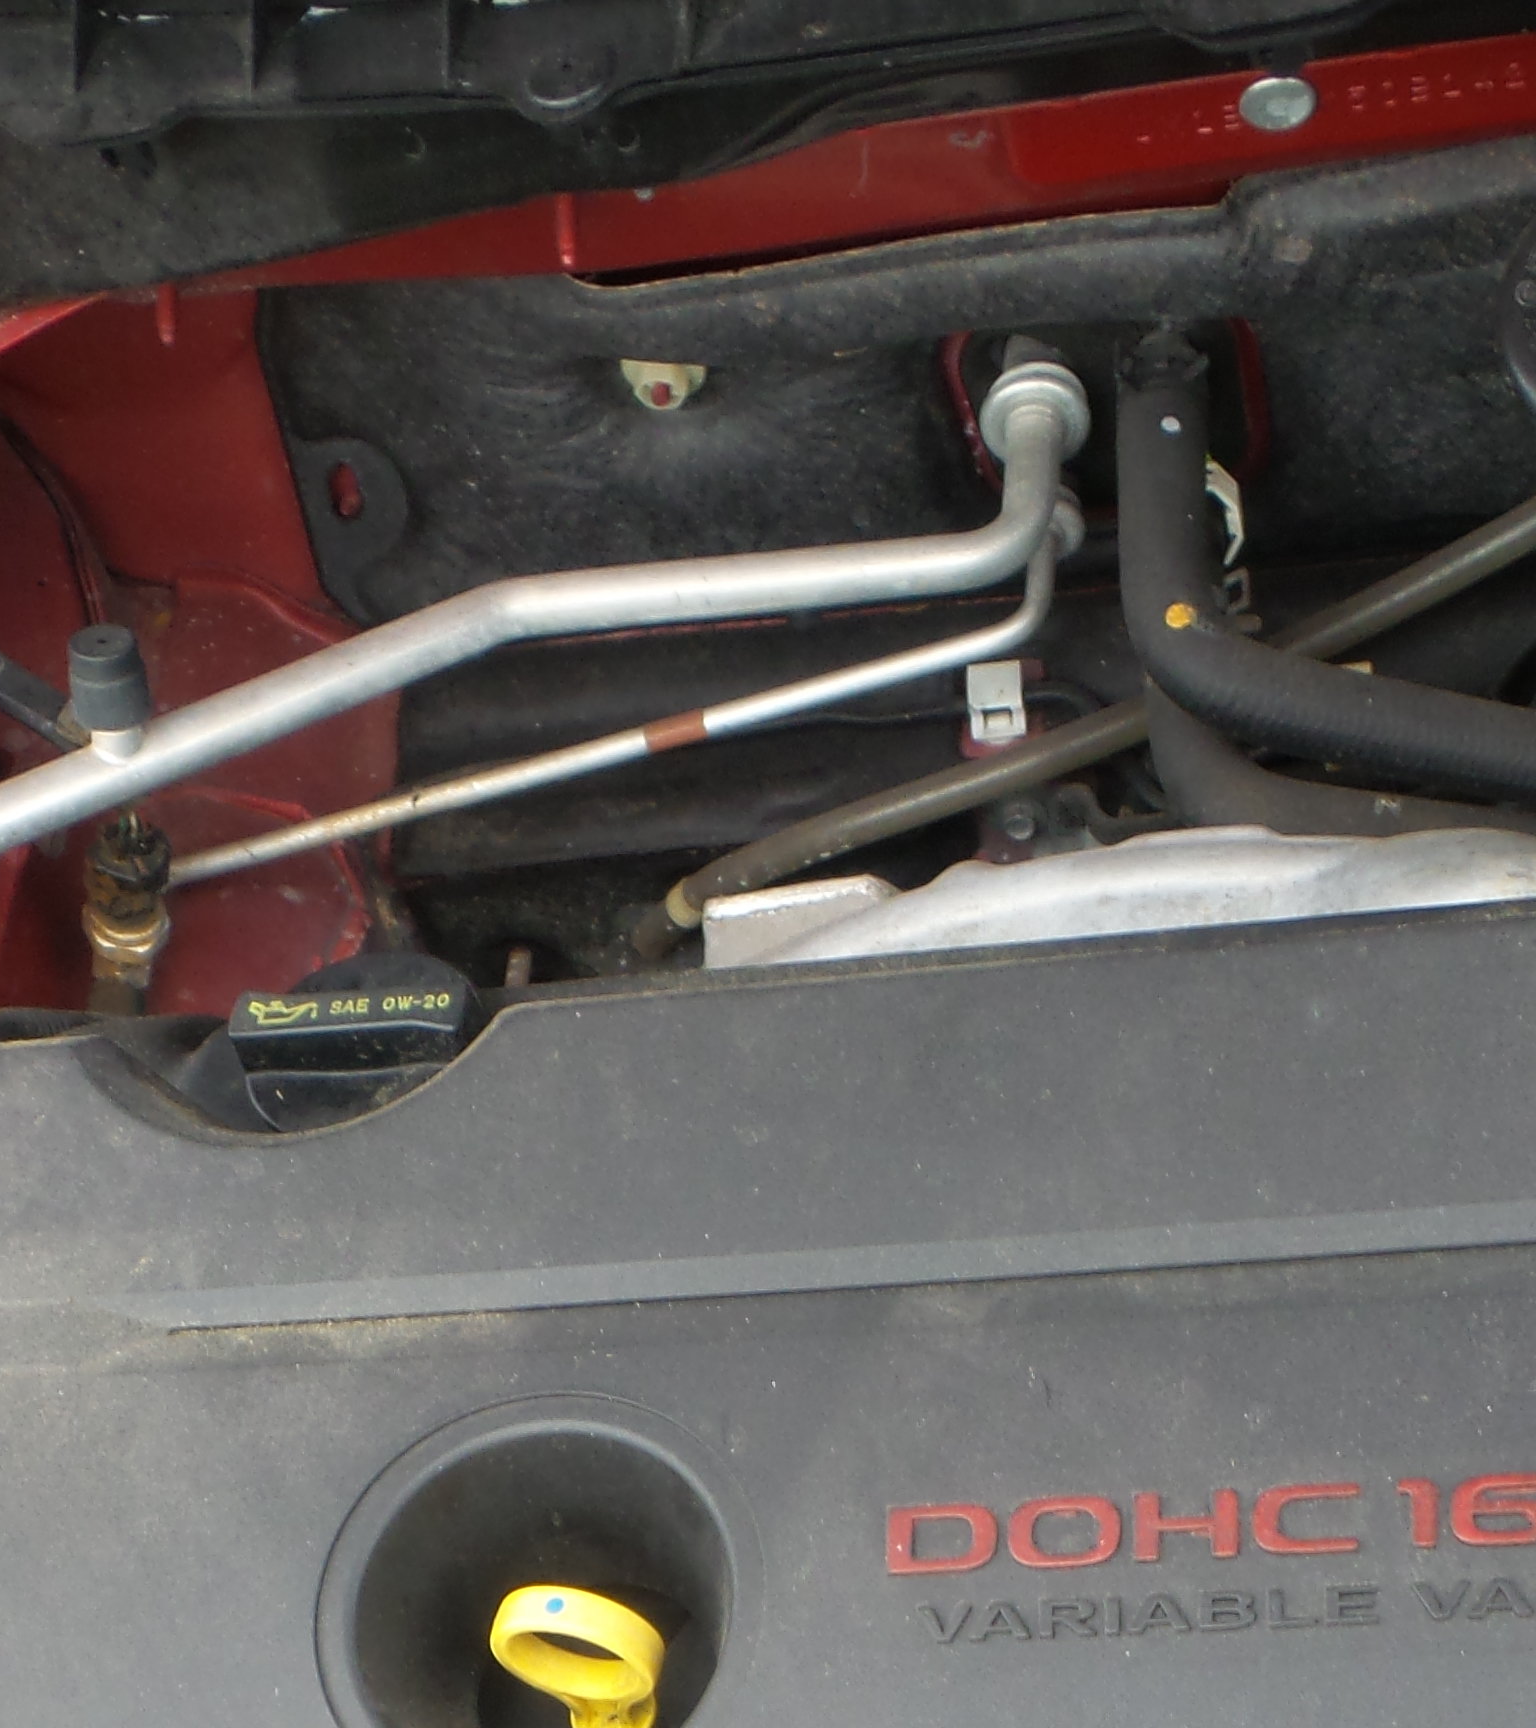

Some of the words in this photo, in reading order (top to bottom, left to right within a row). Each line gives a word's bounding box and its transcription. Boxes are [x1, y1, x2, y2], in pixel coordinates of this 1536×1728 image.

[328, 997, 370, 1015] SAE
[381, 992, 451, 1012] 0W-20
[885, 1482, 1362, 1577] DOHC
[914, 1581, 1381, 1646] VARIABLE
